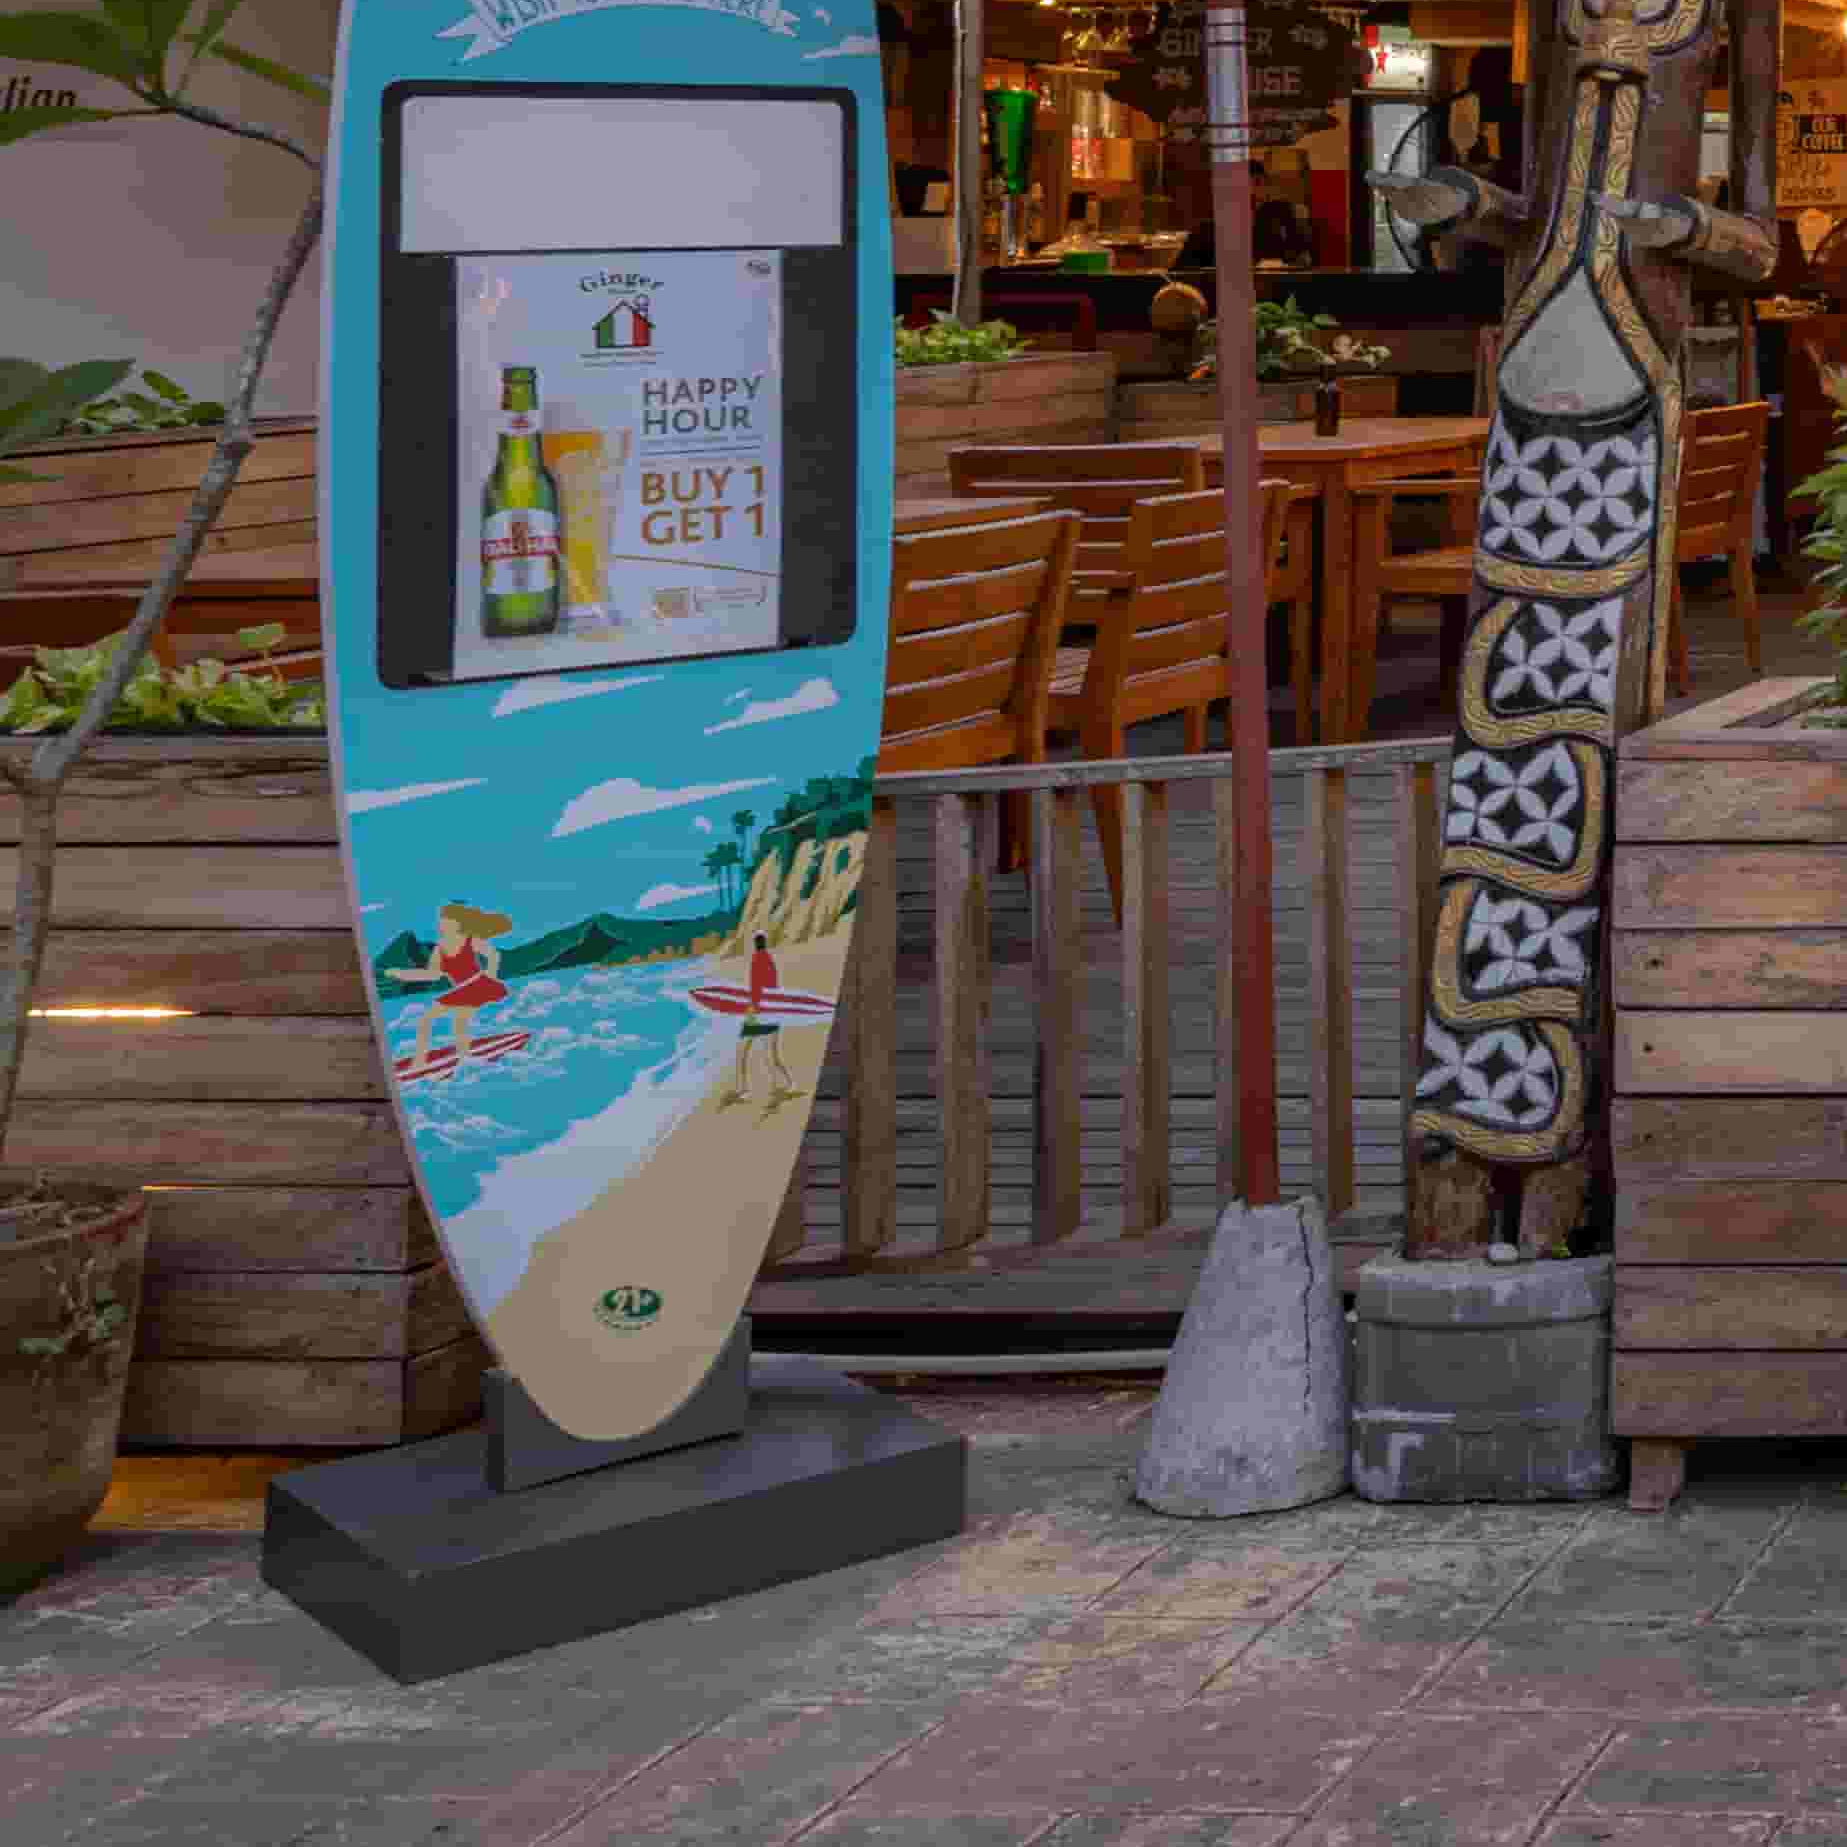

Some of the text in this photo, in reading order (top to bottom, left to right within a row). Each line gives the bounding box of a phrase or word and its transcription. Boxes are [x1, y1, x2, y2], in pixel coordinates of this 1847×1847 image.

[0, 75, 79, 112] lian
[578, 270, 665, 293] Ginger
[642, 374, 762, 406] HAPPY
[642, 405, 753, 435] HOUR
[640, 464, 766, 506] BUY 1
[640, 503, 766, 545] GET 1
